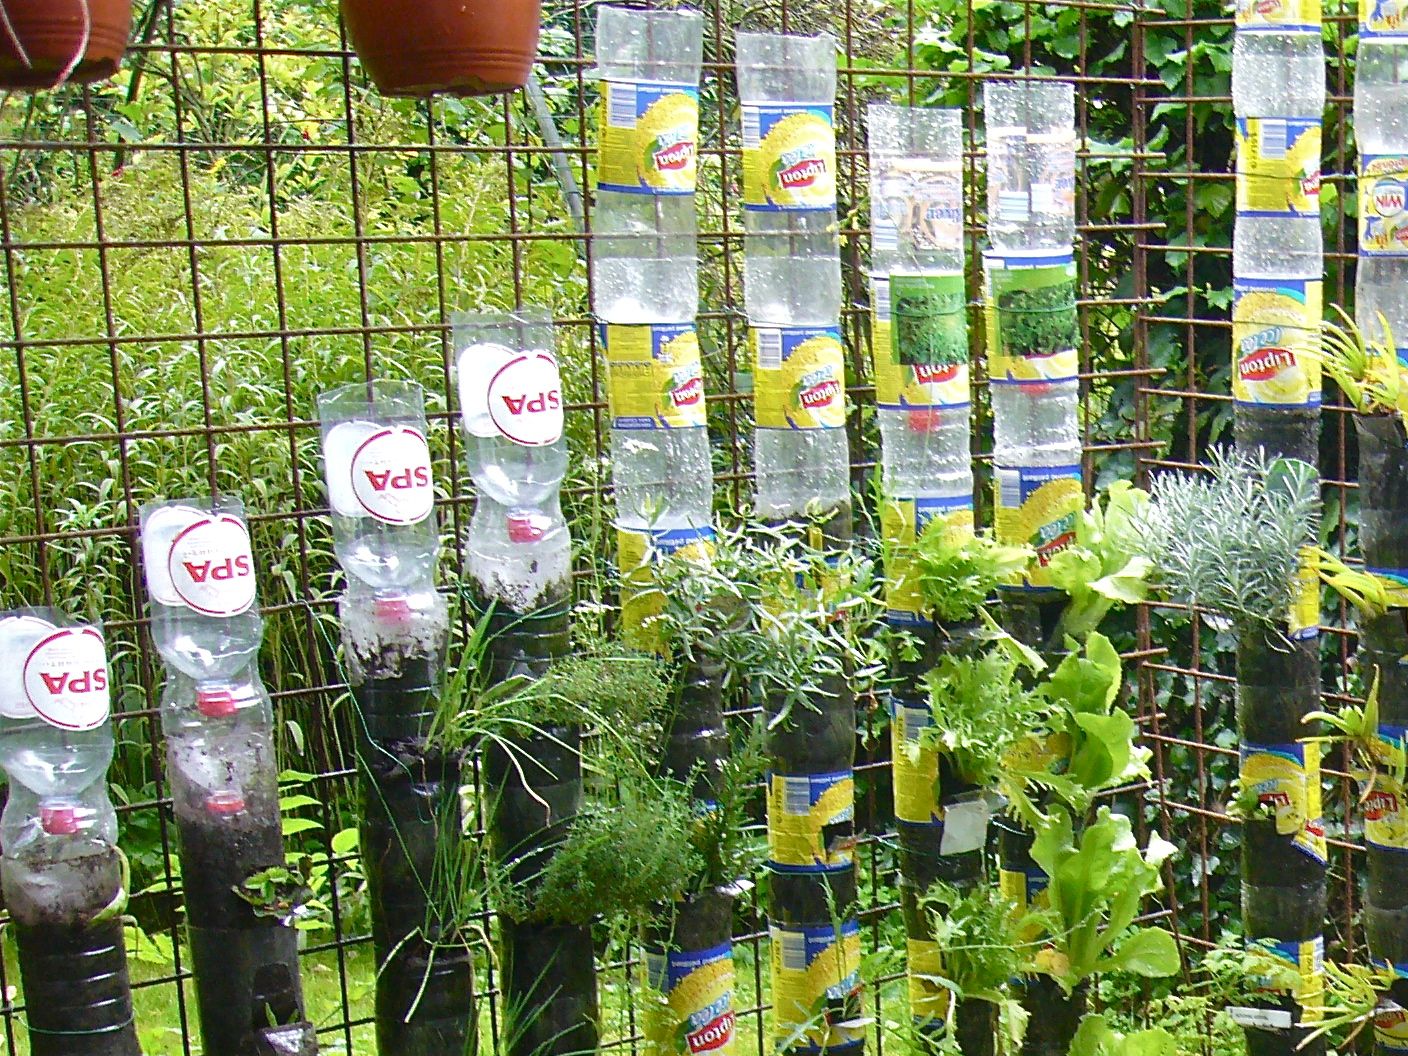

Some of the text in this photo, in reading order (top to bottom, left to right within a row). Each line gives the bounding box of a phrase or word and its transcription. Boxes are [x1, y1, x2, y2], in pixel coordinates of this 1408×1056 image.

[782, 162, 824, 183] Lipton
[1240, 352, 1291, 375] Lipton
[501, 389, 560, 415] SPA
[364, 466, 429, 491] SPA
[182, 555, 250, 583] SPA
[39, 668, 106, 695] SPA
